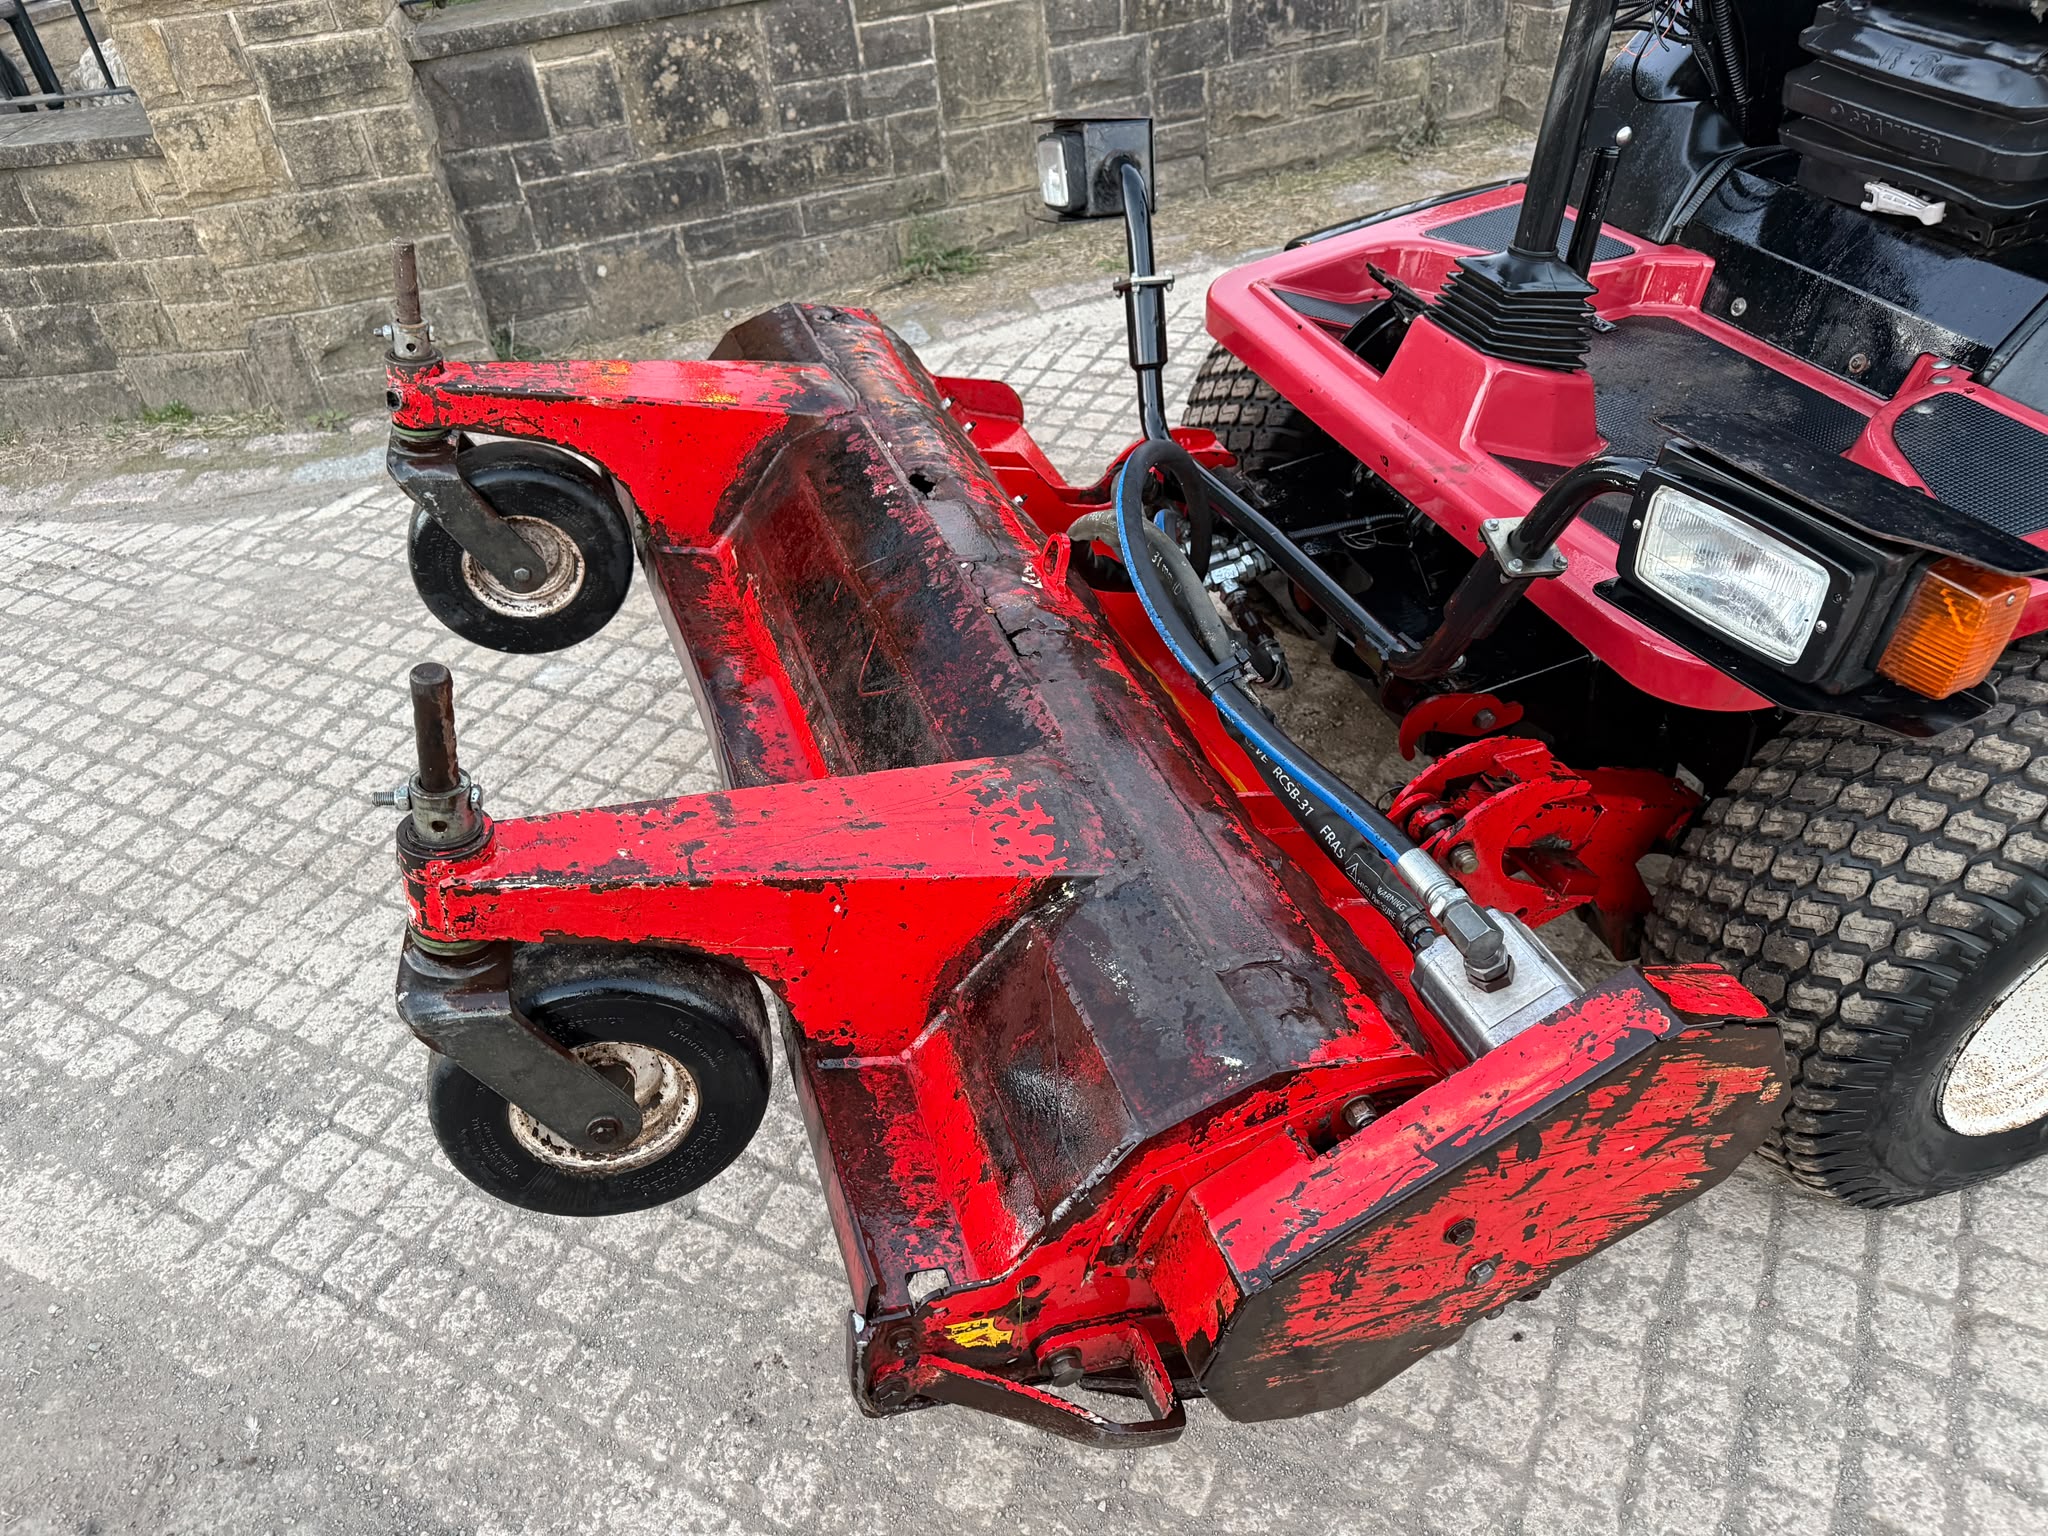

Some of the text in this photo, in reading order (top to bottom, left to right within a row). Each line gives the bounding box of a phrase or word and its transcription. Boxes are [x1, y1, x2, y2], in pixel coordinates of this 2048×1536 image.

[1272, 766, 1315, 817] RCSB-31
[1319, 824, 1347, 859] FRAS
[1377, 885, 1408, 912] WARNING
